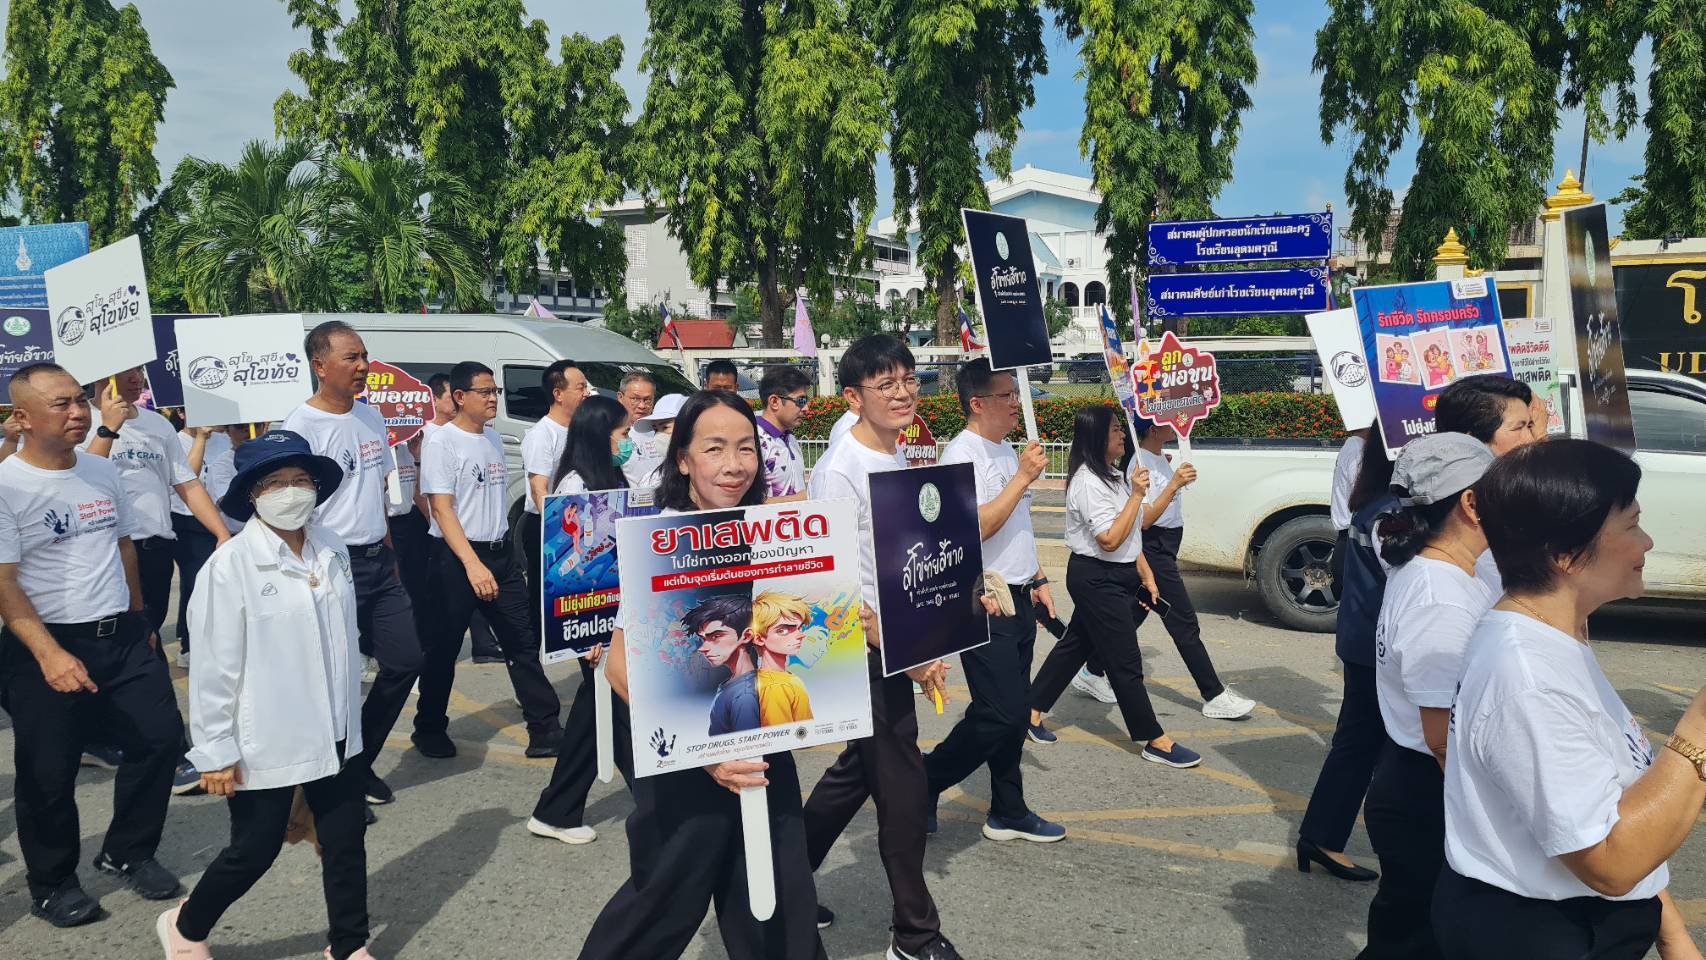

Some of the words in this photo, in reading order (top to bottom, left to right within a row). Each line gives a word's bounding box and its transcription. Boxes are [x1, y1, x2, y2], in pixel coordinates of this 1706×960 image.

[1167, 224, 1311, 242] สมาคมผู้ปกครองนักเรียนและครู
[1196, 241, 1278, 257] โรงเรียนอุดมดรุณี
[1160, 283, 1315, 300] สมาคมศิษย์เก่าโรงเรียนอุดมดรุณี
[90, 299, 139, 335] สุโขทัย
[1378, 310, 1415, 328] รักชีวิต
[1416, 304, 1481, 324] รักครอบครัว
[1161, 350, 1182, 372] ลูก
[233, 362, 299, 387] สุโขทัย
[1161, 364, 1213, 391] พ่อขุน
[369, 387, 431, 409] พ่อขุน
[651, 510, 830, 555] ยาเสพติด
[670, 544, 815, 570] ไม่ใช่ทางออกของปัญหา
[663, 560, 824, 588] แต่เป็นจุดเริ่มต้นของการทำลายชีวิต
[685, 744, 707, 754] STOP
[707, 738, 736, 750] DRUGS,
[737, 733, 762, 744] START
[762, 728, 791, 740] POWER
